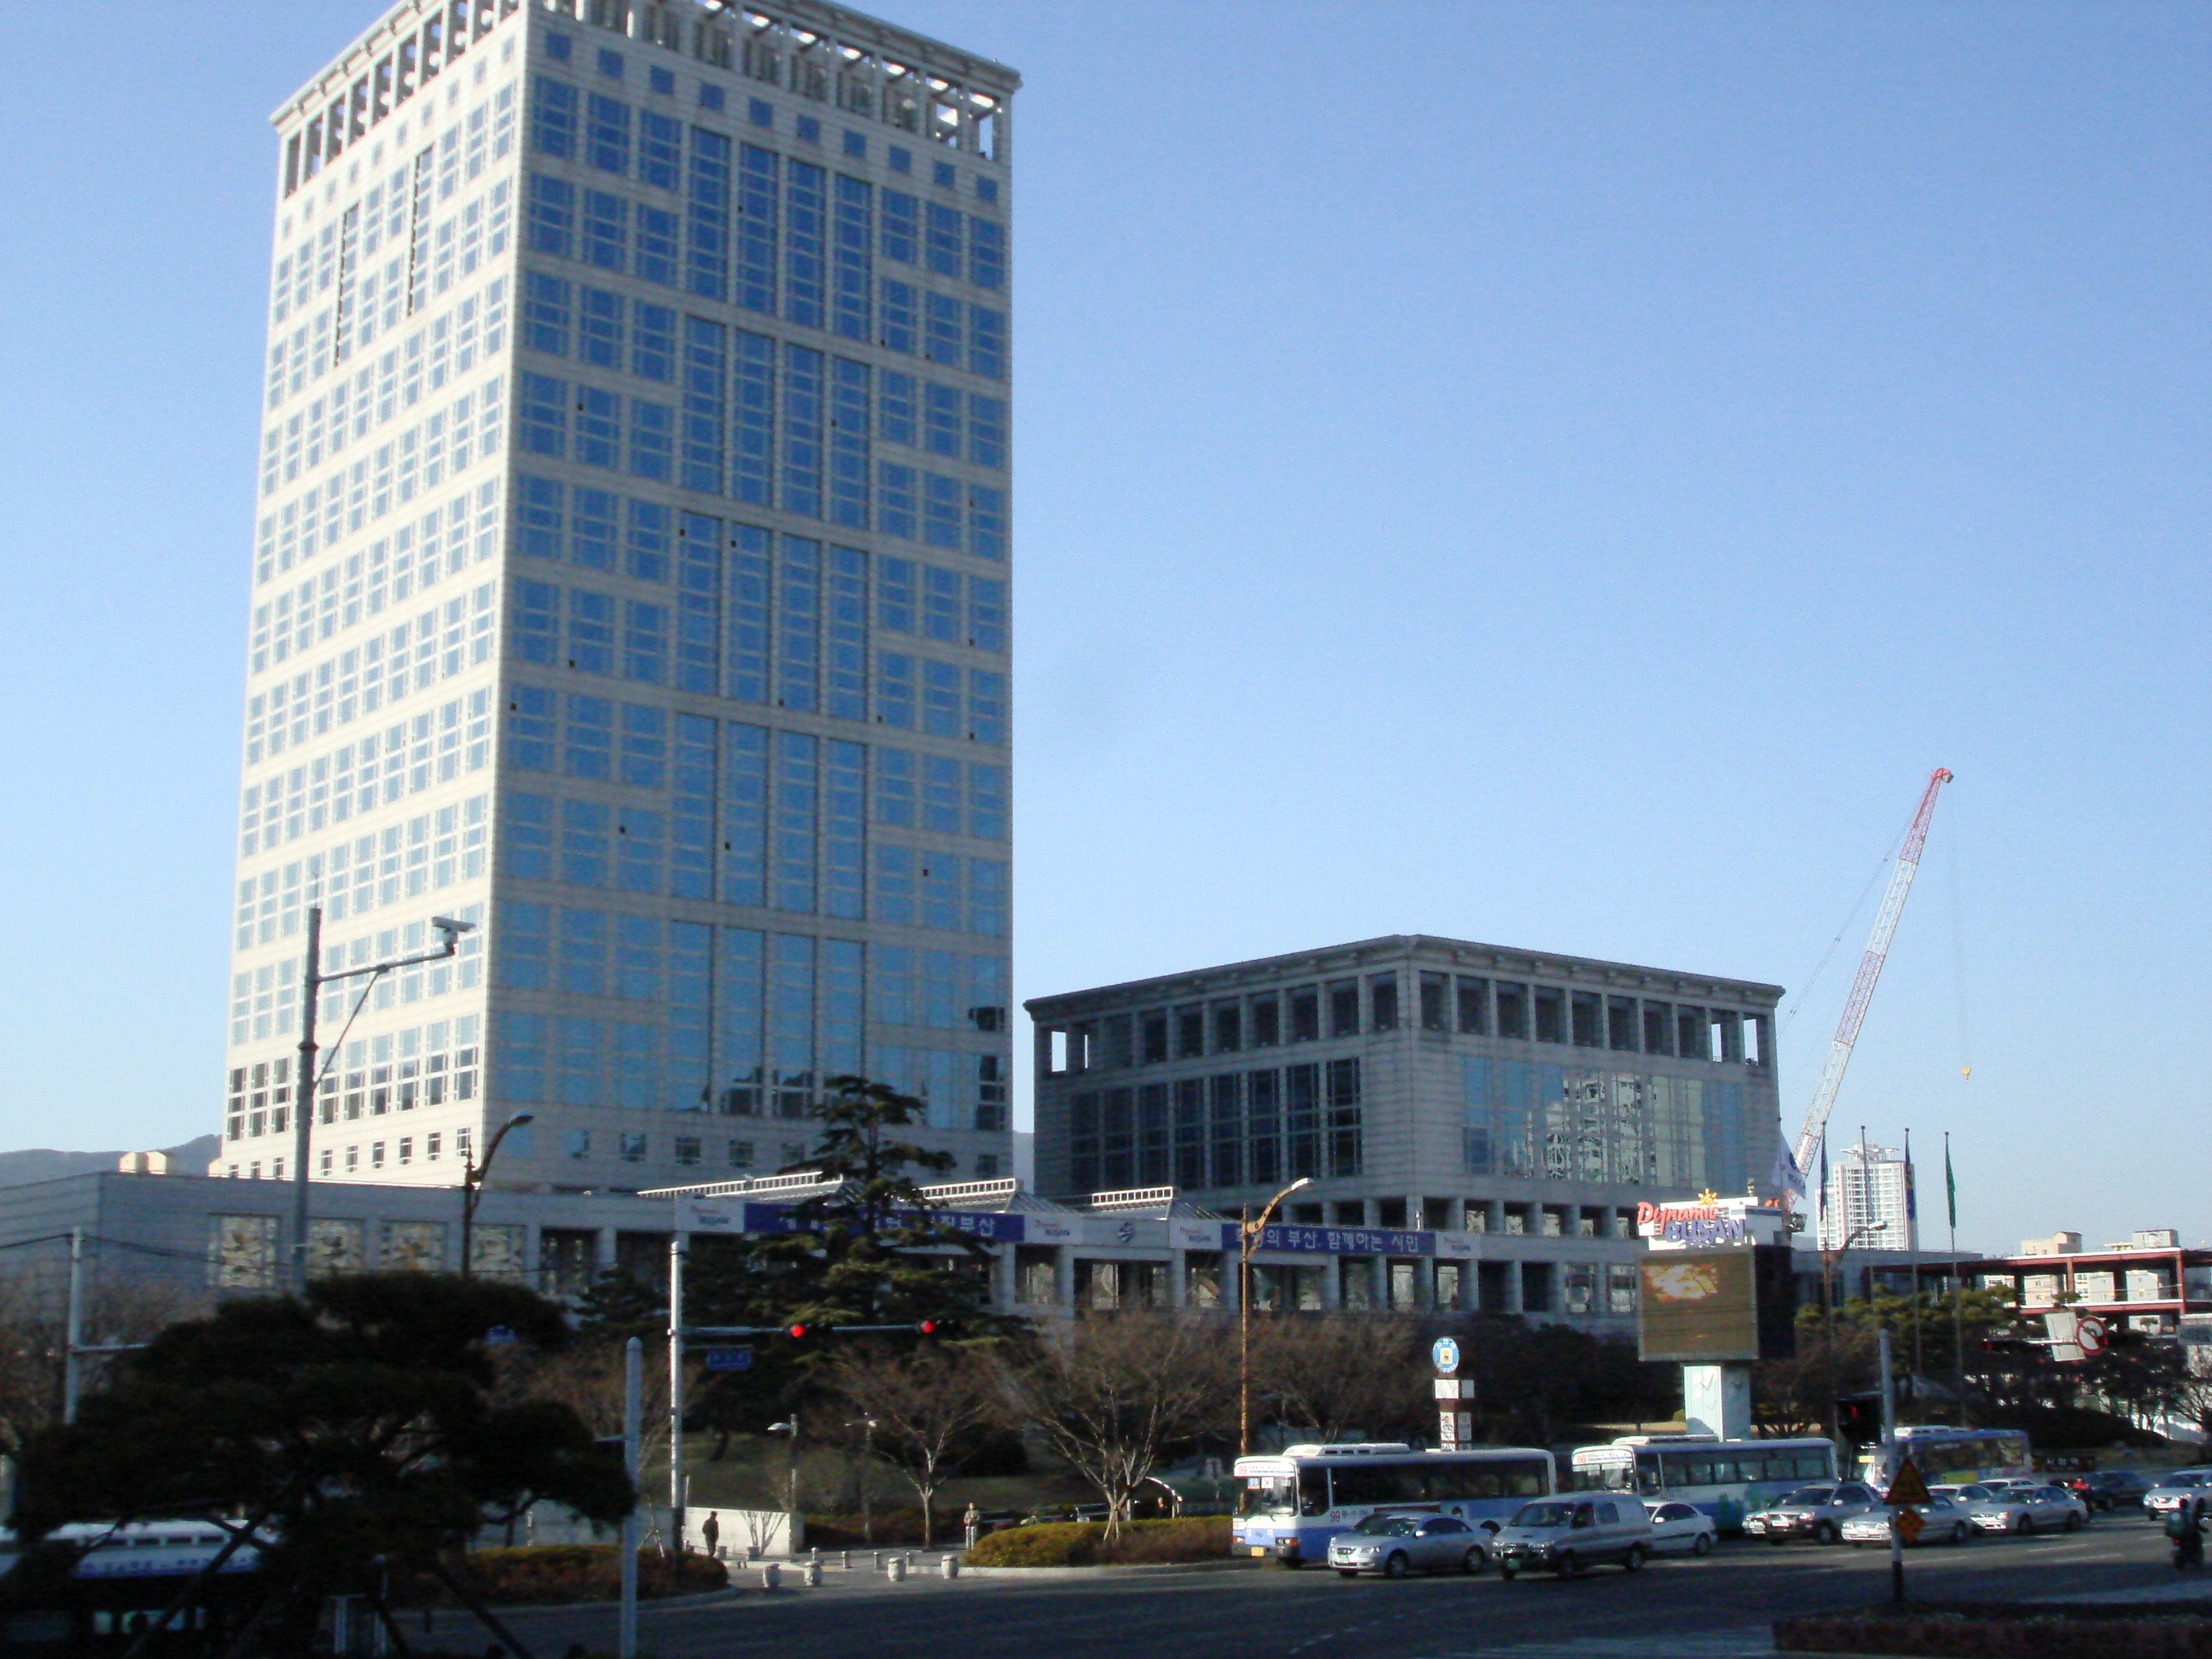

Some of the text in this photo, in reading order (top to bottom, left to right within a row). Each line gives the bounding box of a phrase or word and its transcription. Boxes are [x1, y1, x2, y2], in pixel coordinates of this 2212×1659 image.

[1637, 1201, 1721, 1235] Dynamic
[1665, 1219, 1746, 1244] BUSAN
[1576, 1454, 1586, 1464] 86
[1238, 1465, 1248, 1475] 99
[1330, 1510, 1341, 1522] 99
